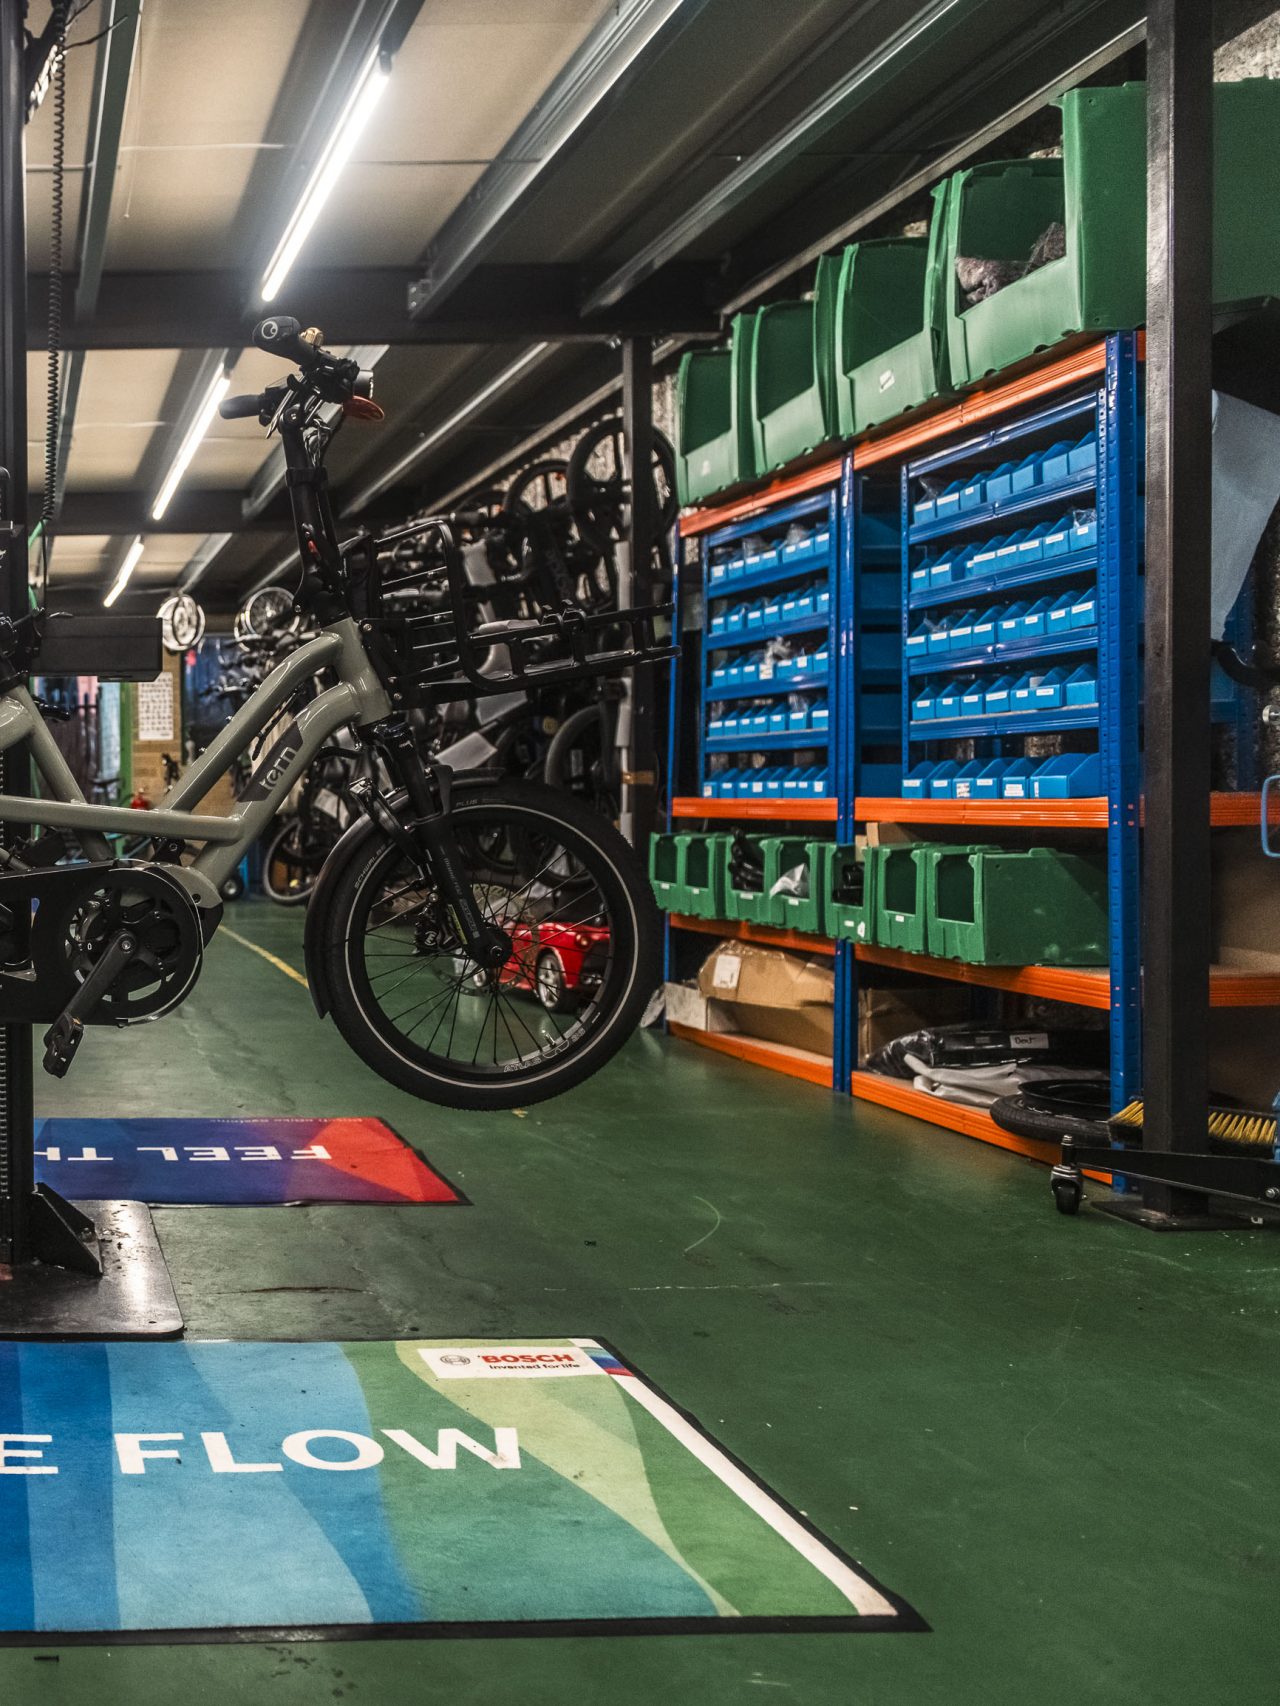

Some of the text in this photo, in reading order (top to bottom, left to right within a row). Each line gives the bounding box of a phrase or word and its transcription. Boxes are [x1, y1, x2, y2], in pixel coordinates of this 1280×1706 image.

[258, 746, 298, 791] tern
[135, 1145, 333, 1161] FEEL
[481, 1354, 575, 1364] BOSCH
[113, 1427, 523, 1475] FLOW
